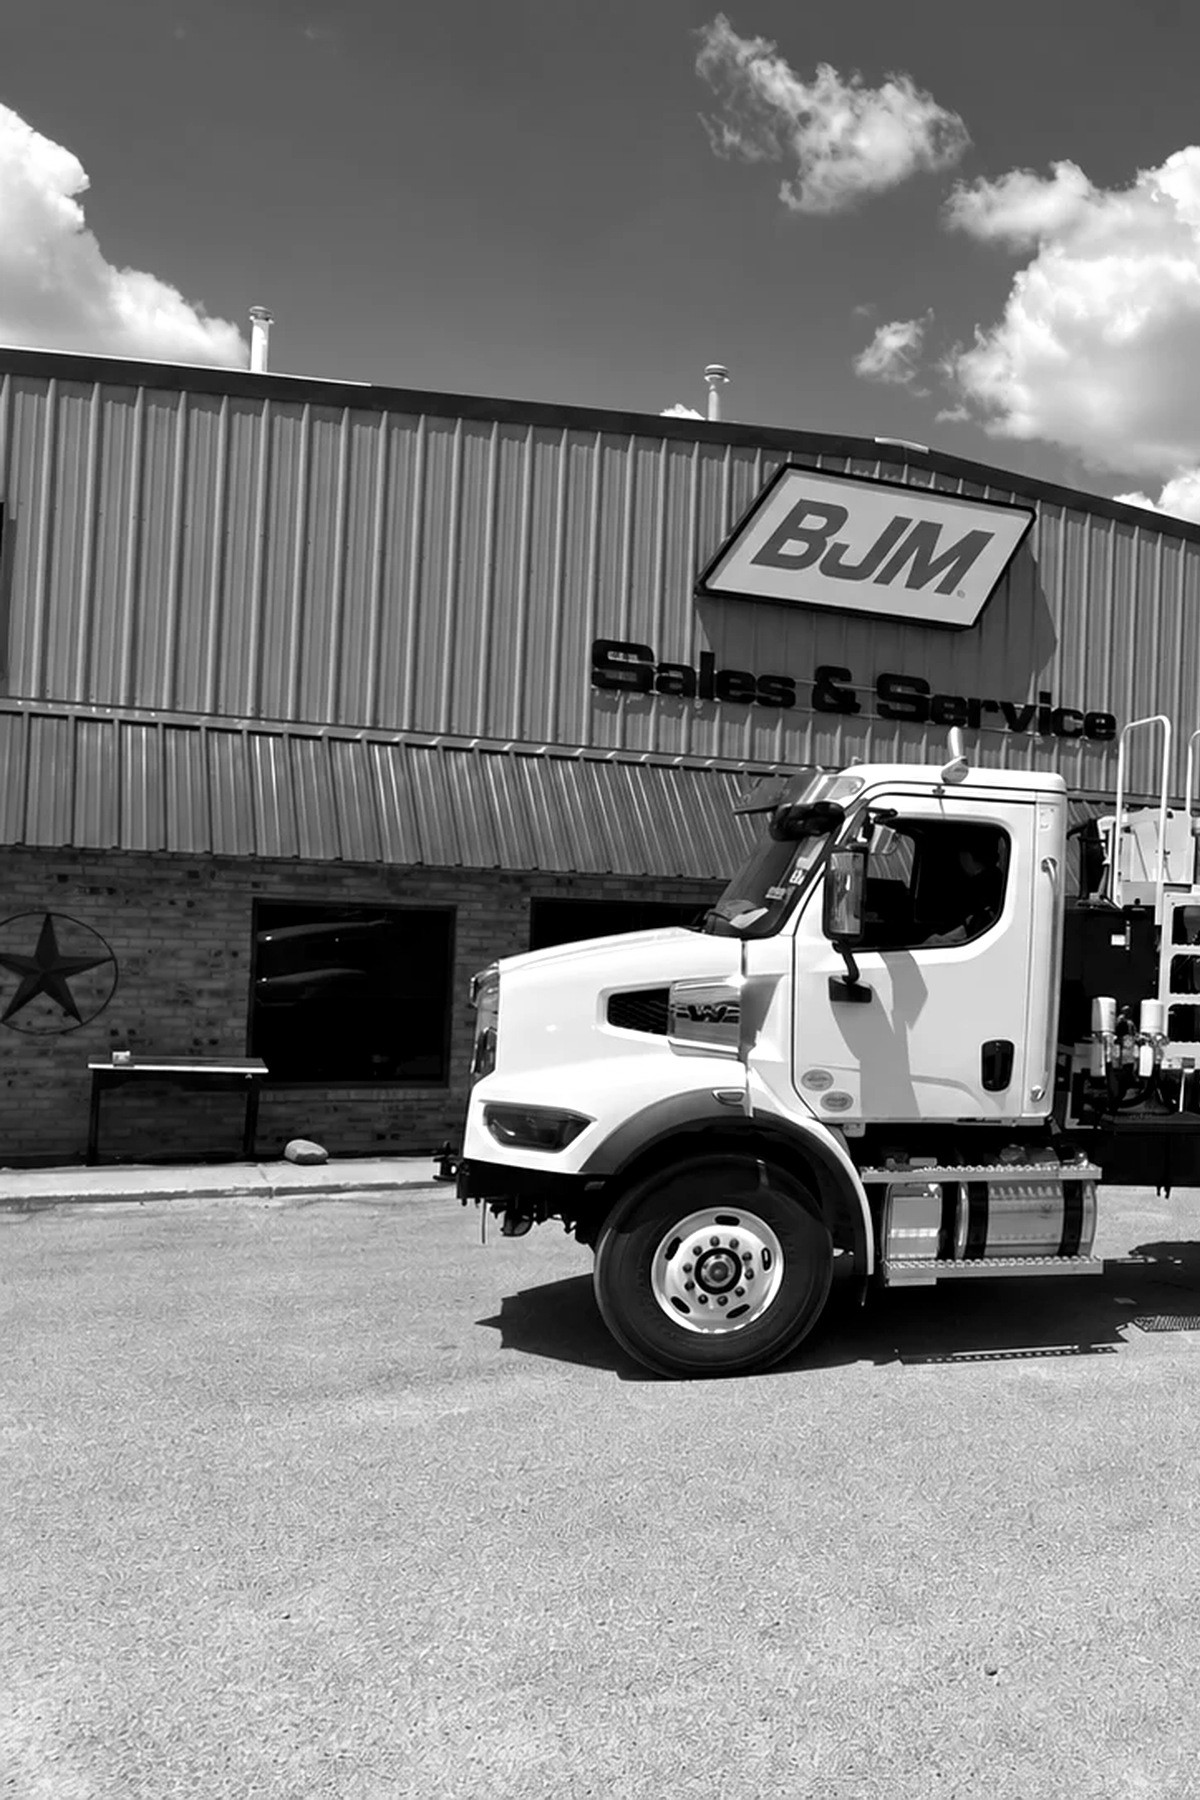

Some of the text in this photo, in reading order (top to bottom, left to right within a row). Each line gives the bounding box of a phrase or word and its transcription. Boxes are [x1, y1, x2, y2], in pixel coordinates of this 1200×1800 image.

[751, 499, 996, 596] BJM
[591, 638, 1117, 741] Sales & Service
